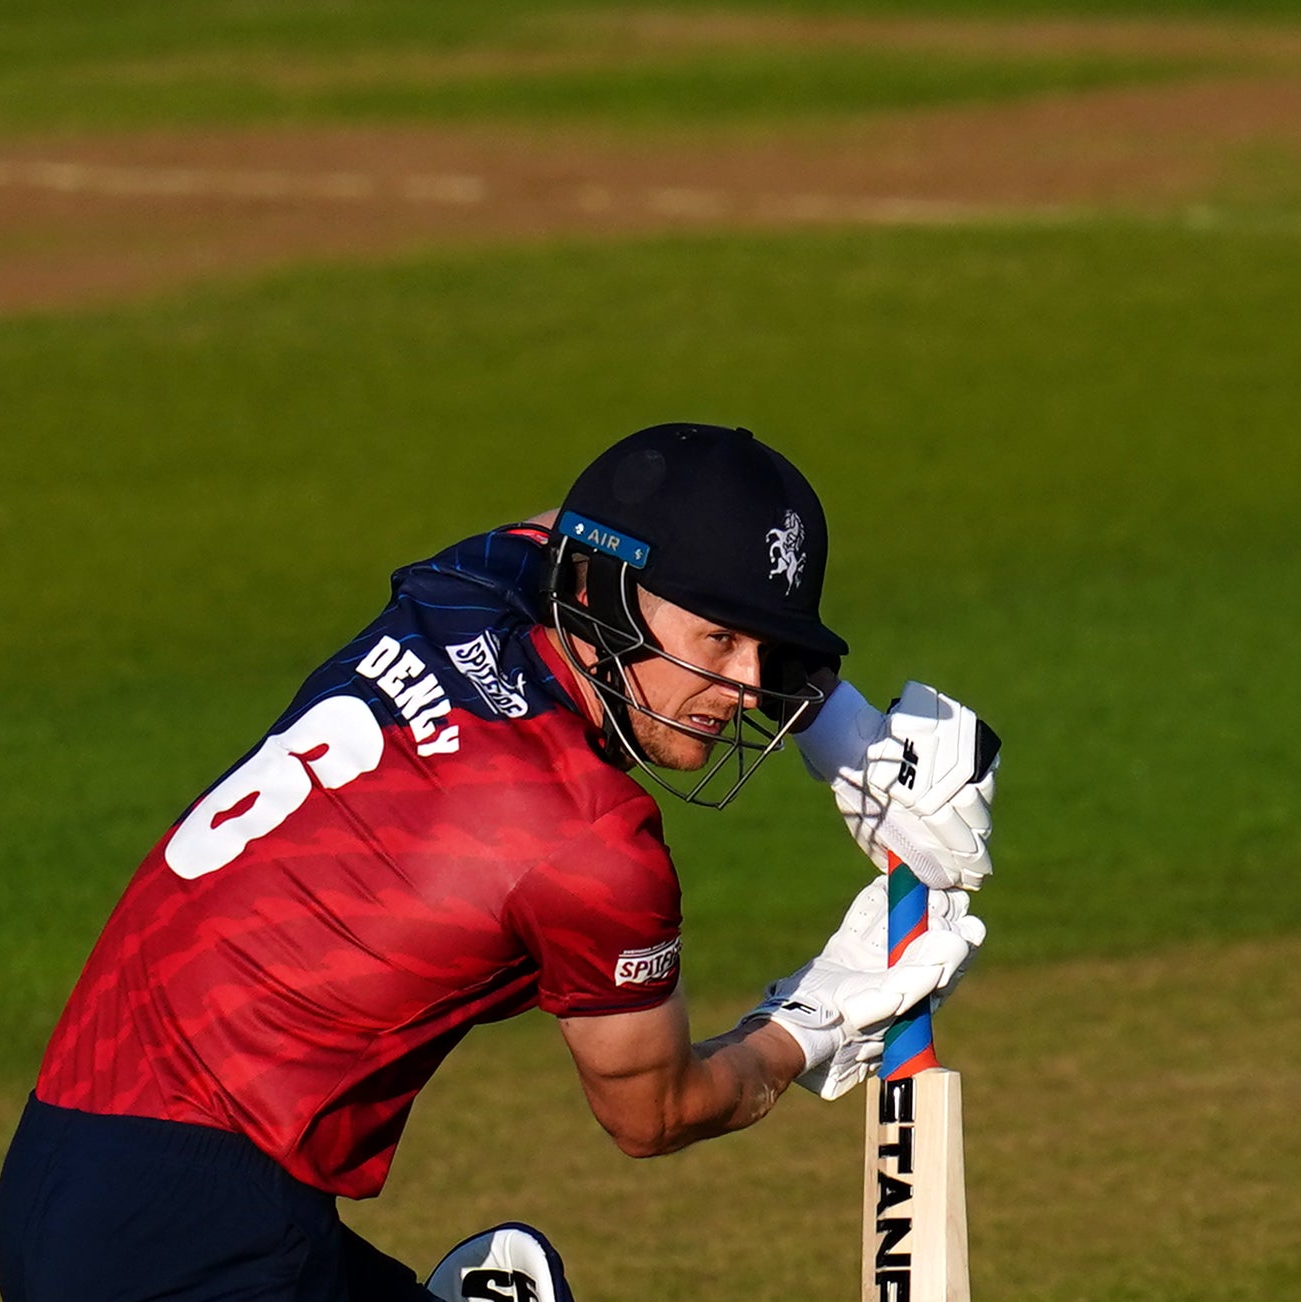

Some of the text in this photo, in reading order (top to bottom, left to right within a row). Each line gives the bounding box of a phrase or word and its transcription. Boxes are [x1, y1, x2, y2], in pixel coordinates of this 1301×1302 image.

[587, 528, 621, 552] AIR
[356, 635, 460, 757] DENLY
[165, 695, 385, 880] 6
[898, 737, 920, 790] SF
